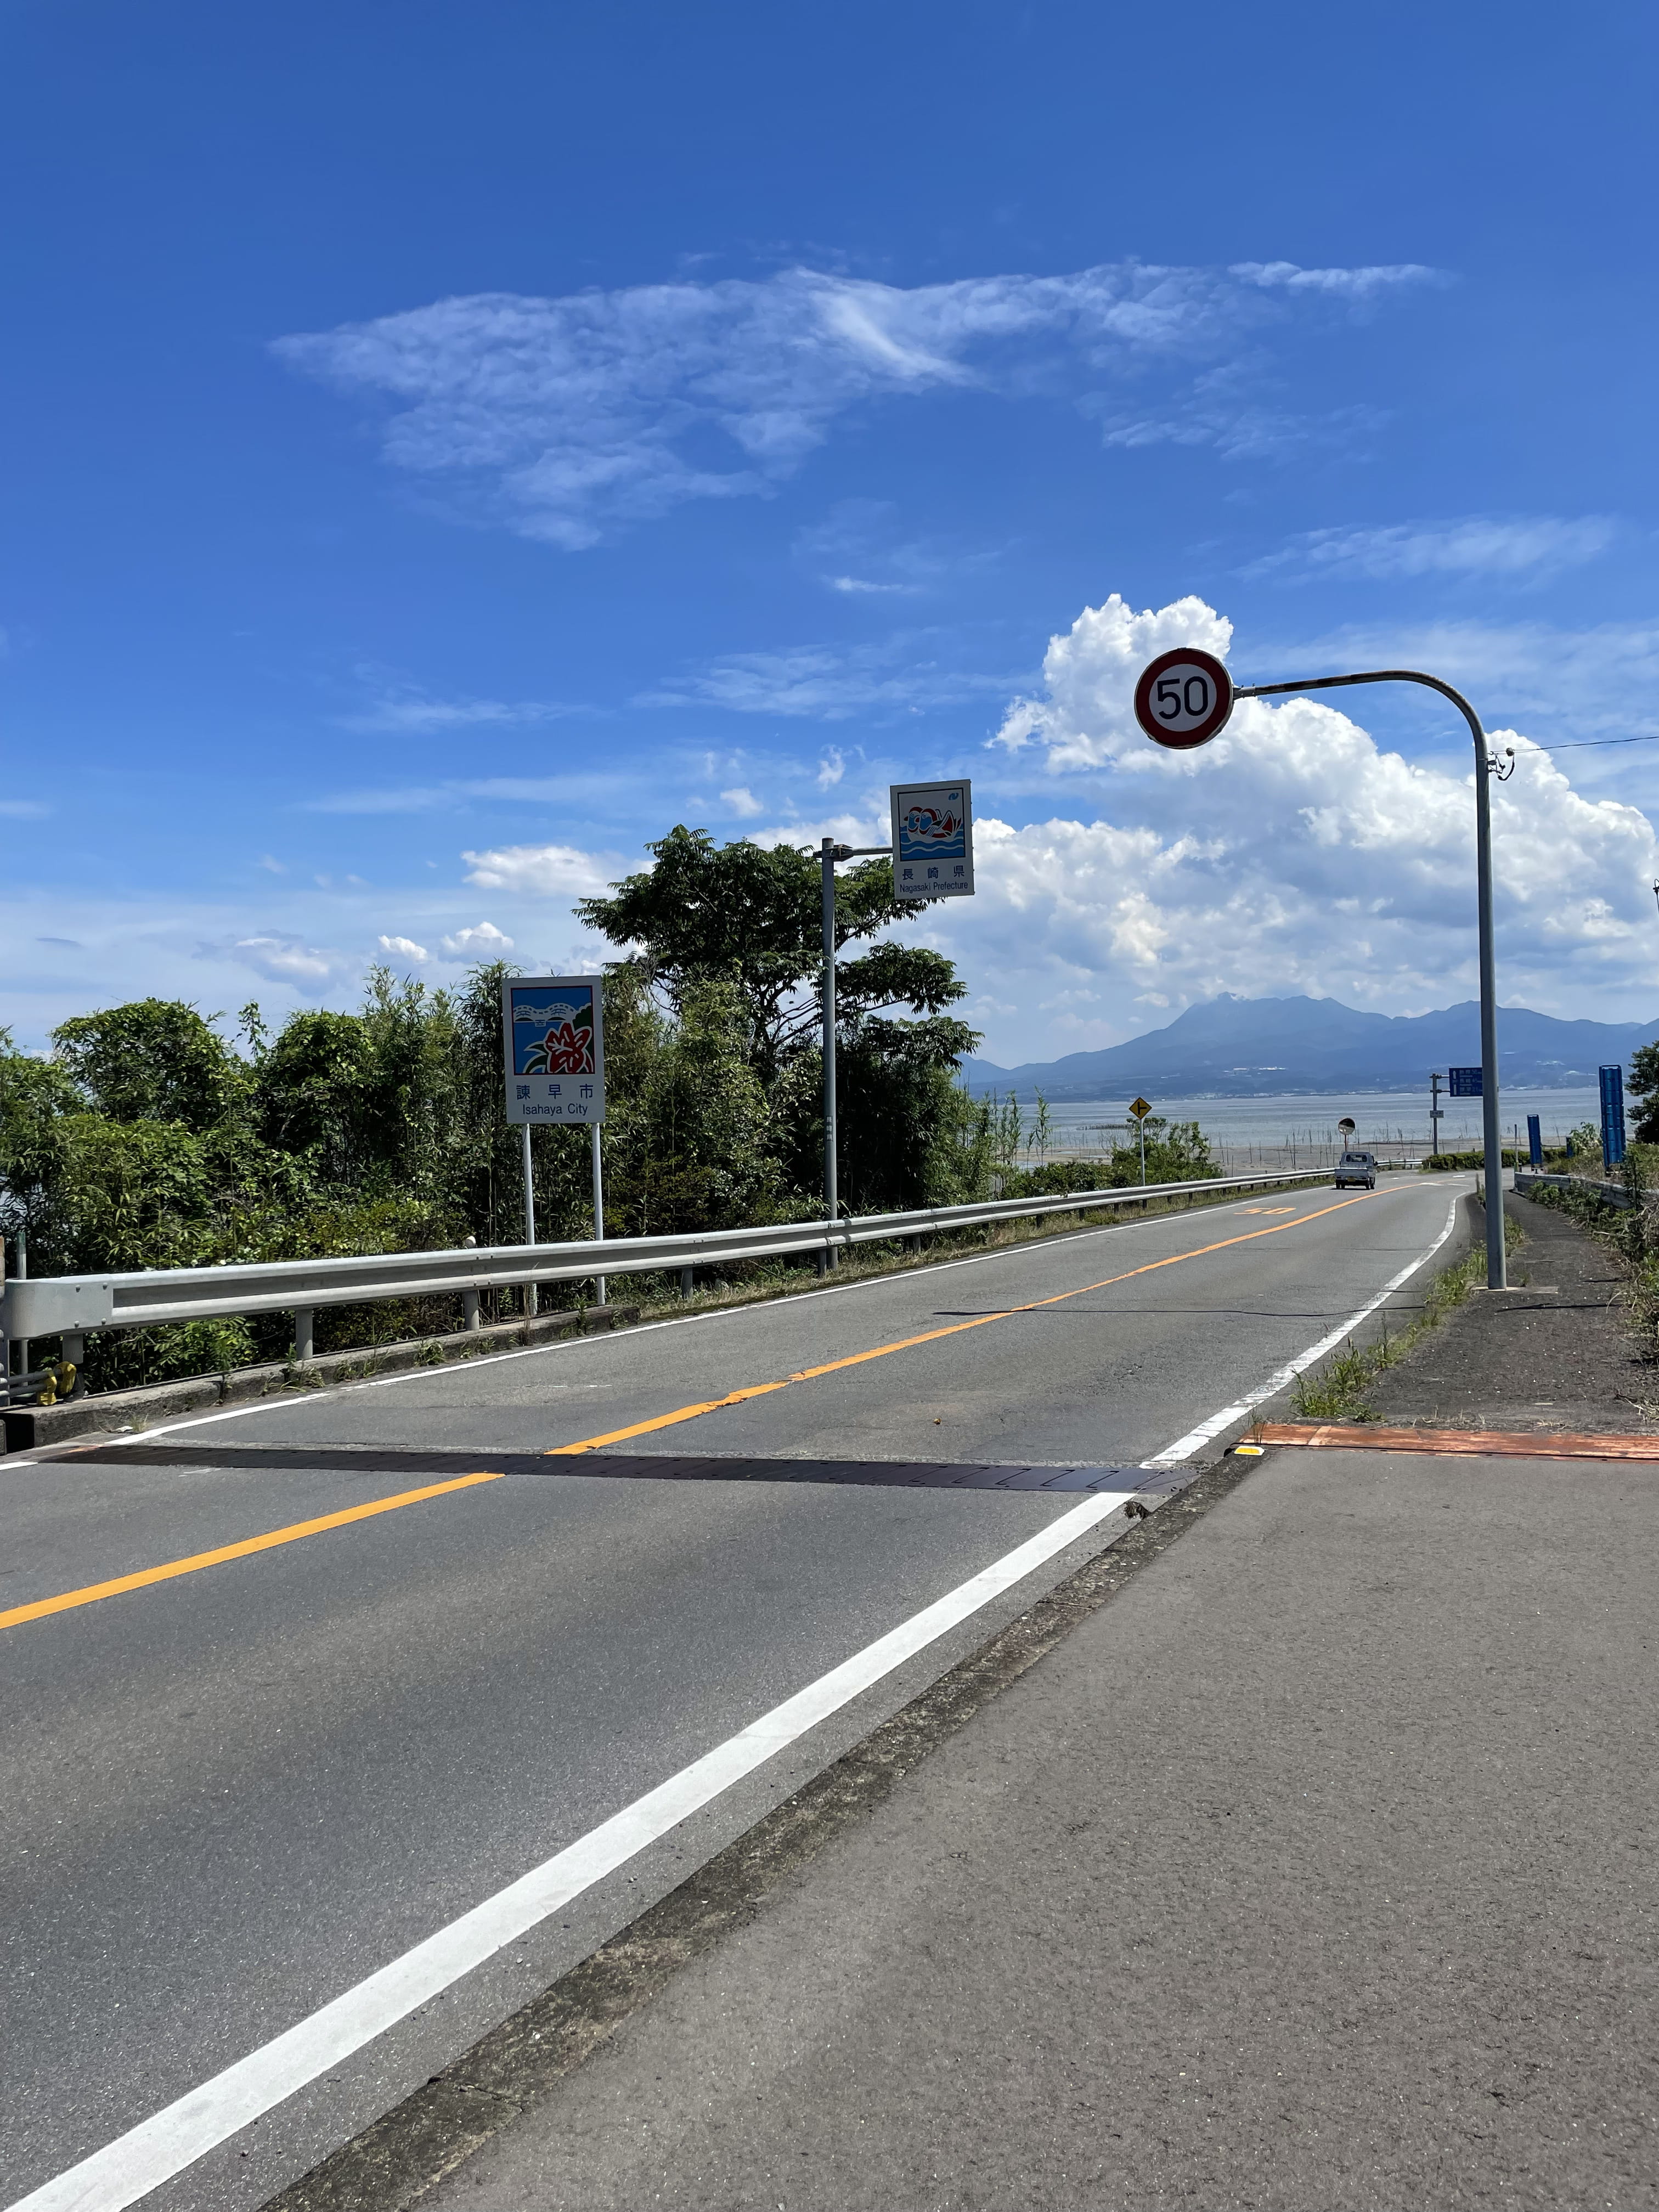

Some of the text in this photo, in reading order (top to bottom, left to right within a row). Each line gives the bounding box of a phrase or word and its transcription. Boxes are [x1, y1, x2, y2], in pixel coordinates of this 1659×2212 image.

[1157, 676, 1209, 719] 50
[902, 865, 965, 881] 長崎県
[900, 881, 968, 894] Nagasaki Prefecture
[522, 1103, 588, 1116] Isahaya City
